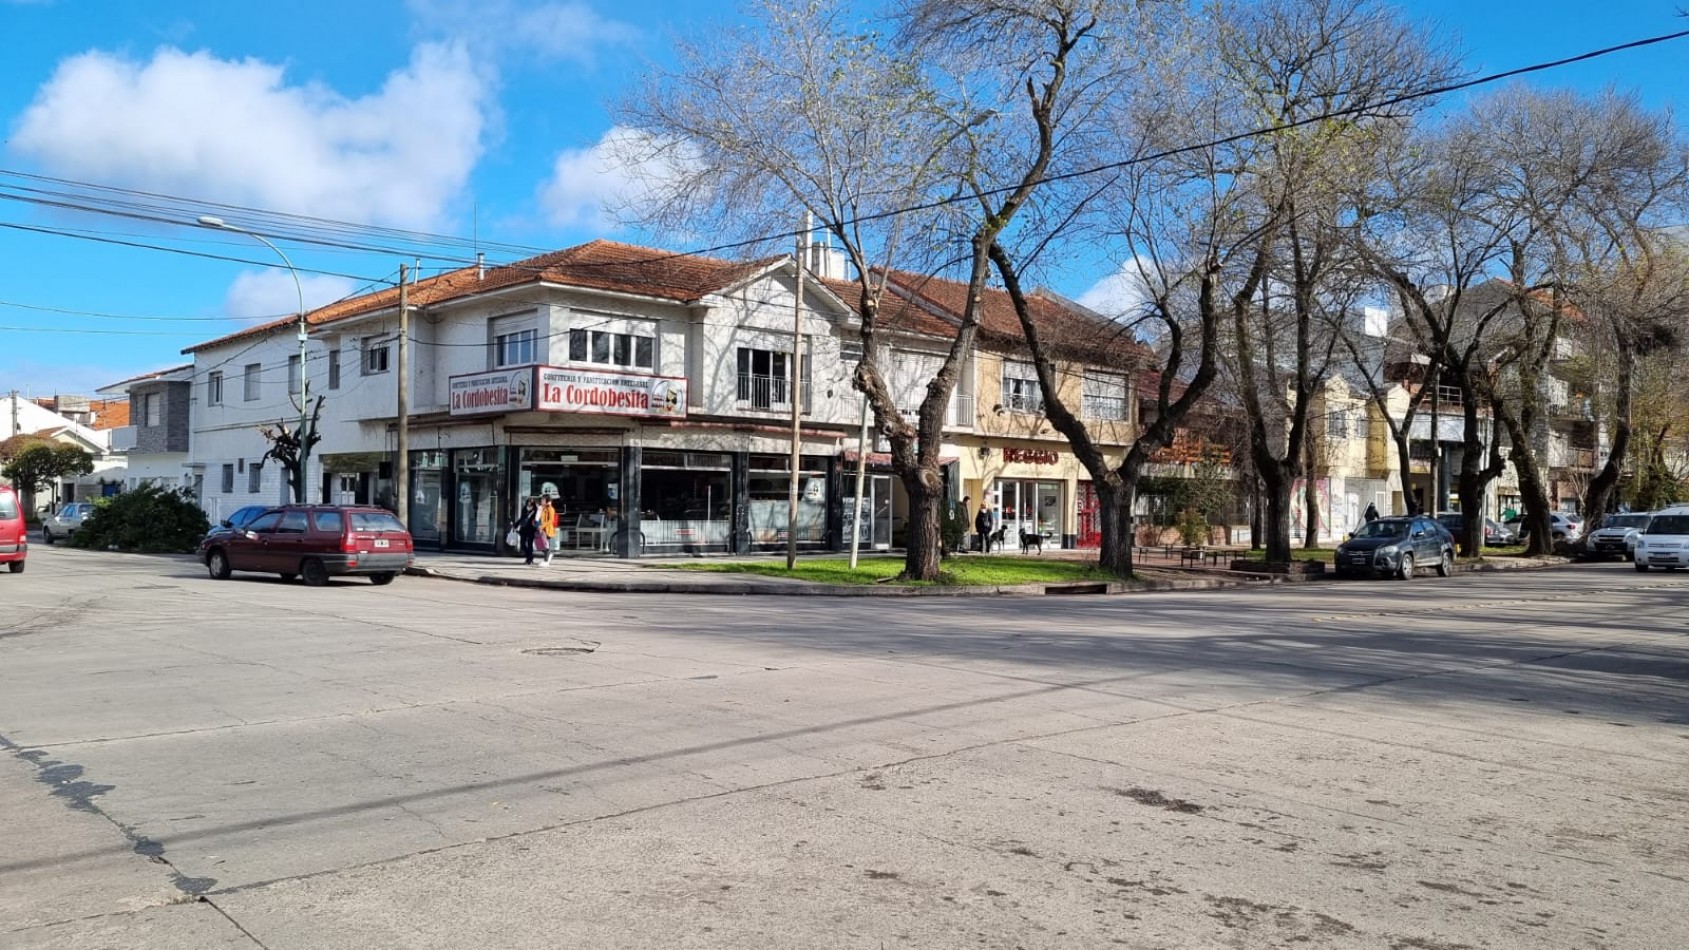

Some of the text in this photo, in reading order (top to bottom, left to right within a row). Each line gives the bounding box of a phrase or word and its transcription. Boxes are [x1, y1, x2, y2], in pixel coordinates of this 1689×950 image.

[452, 391, 461, 410] La
[462, 386, 508, 409] Cordobesita
[544, 383, 560, 403] La
[566, 384, 649, 409] Cordobesita
[1003, 447, 1059, 466] REGGIO
